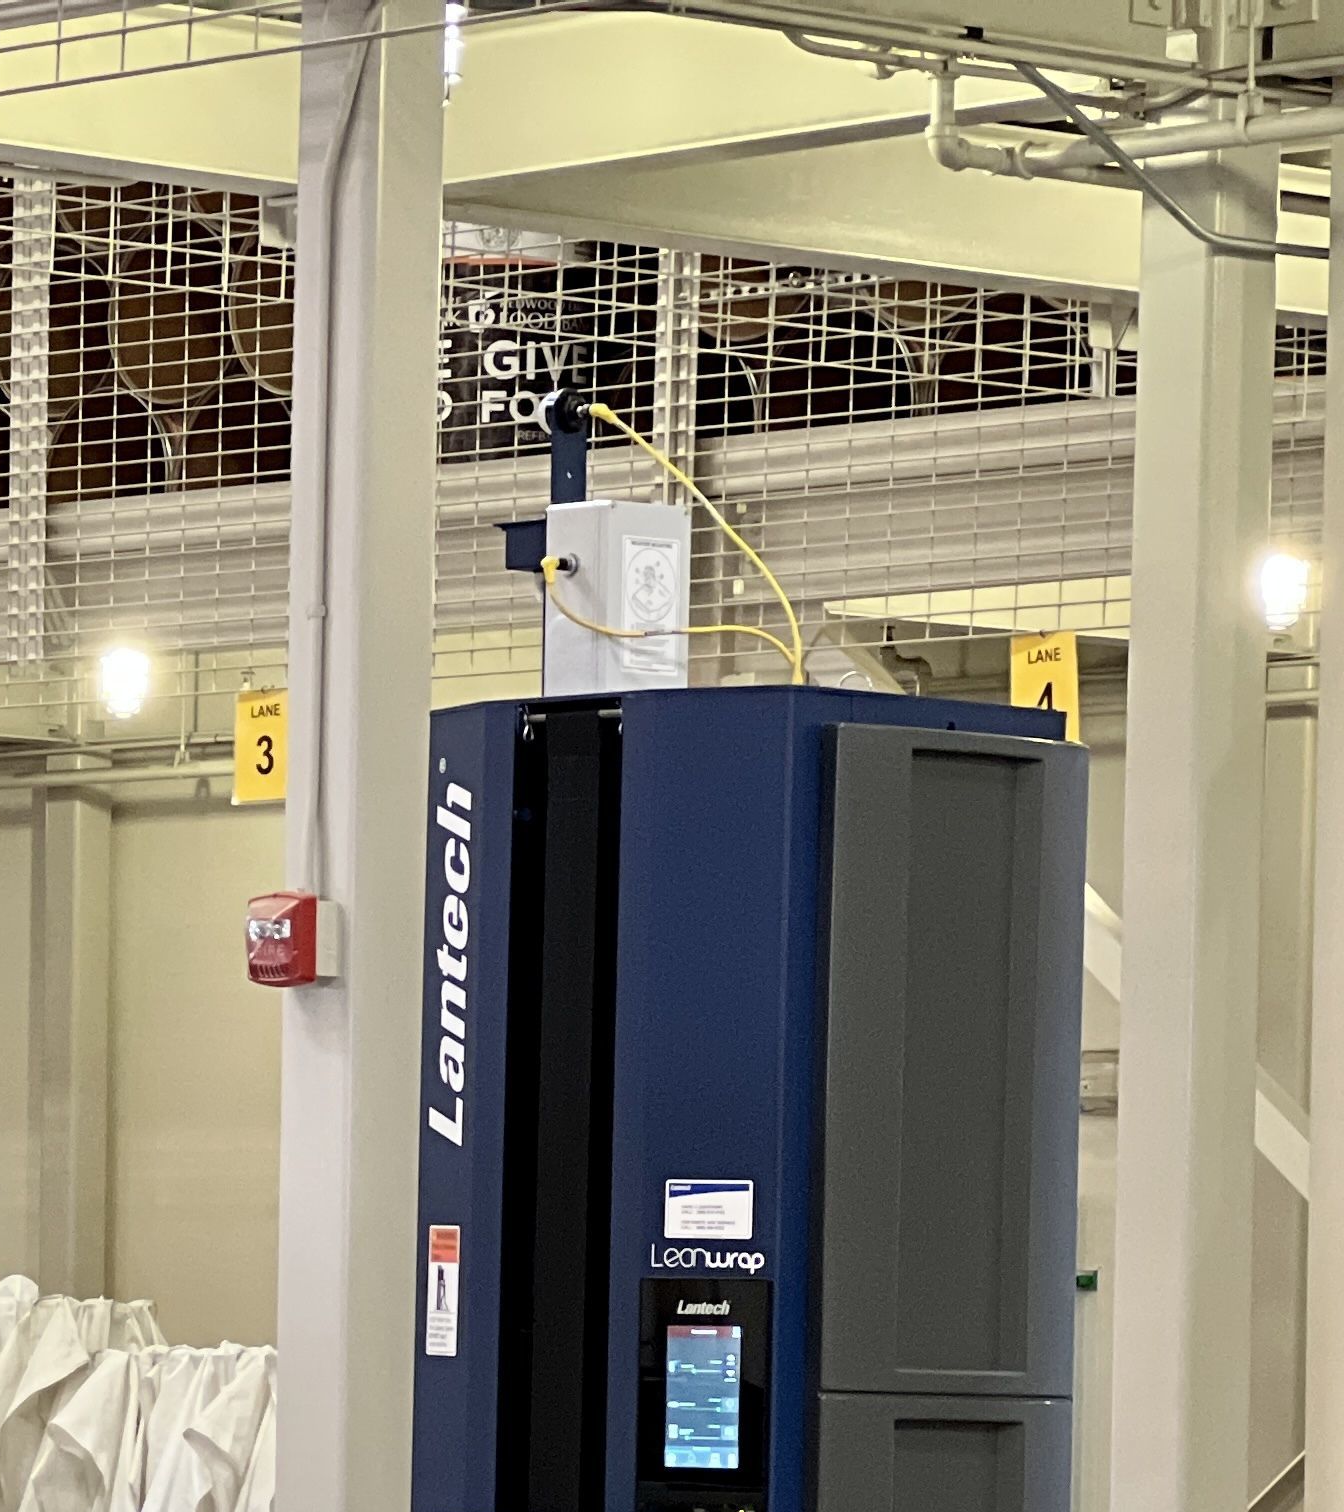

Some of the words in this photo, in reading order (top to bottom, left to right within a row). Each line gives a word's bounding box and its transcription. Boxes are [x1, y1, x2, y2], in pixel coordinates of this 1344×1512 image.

[484, 340, 587, 384] GIVE
[1027, 647, 1062, 665] LANE
[250, 703, 281, 718] LANE
[255, 735, 275, 775] 3
[428, 782, 472, 1147] Lantech
[650, 1243, 765, 1275] Leanwrap
[677, 1300, 730, 1316] Lantech
